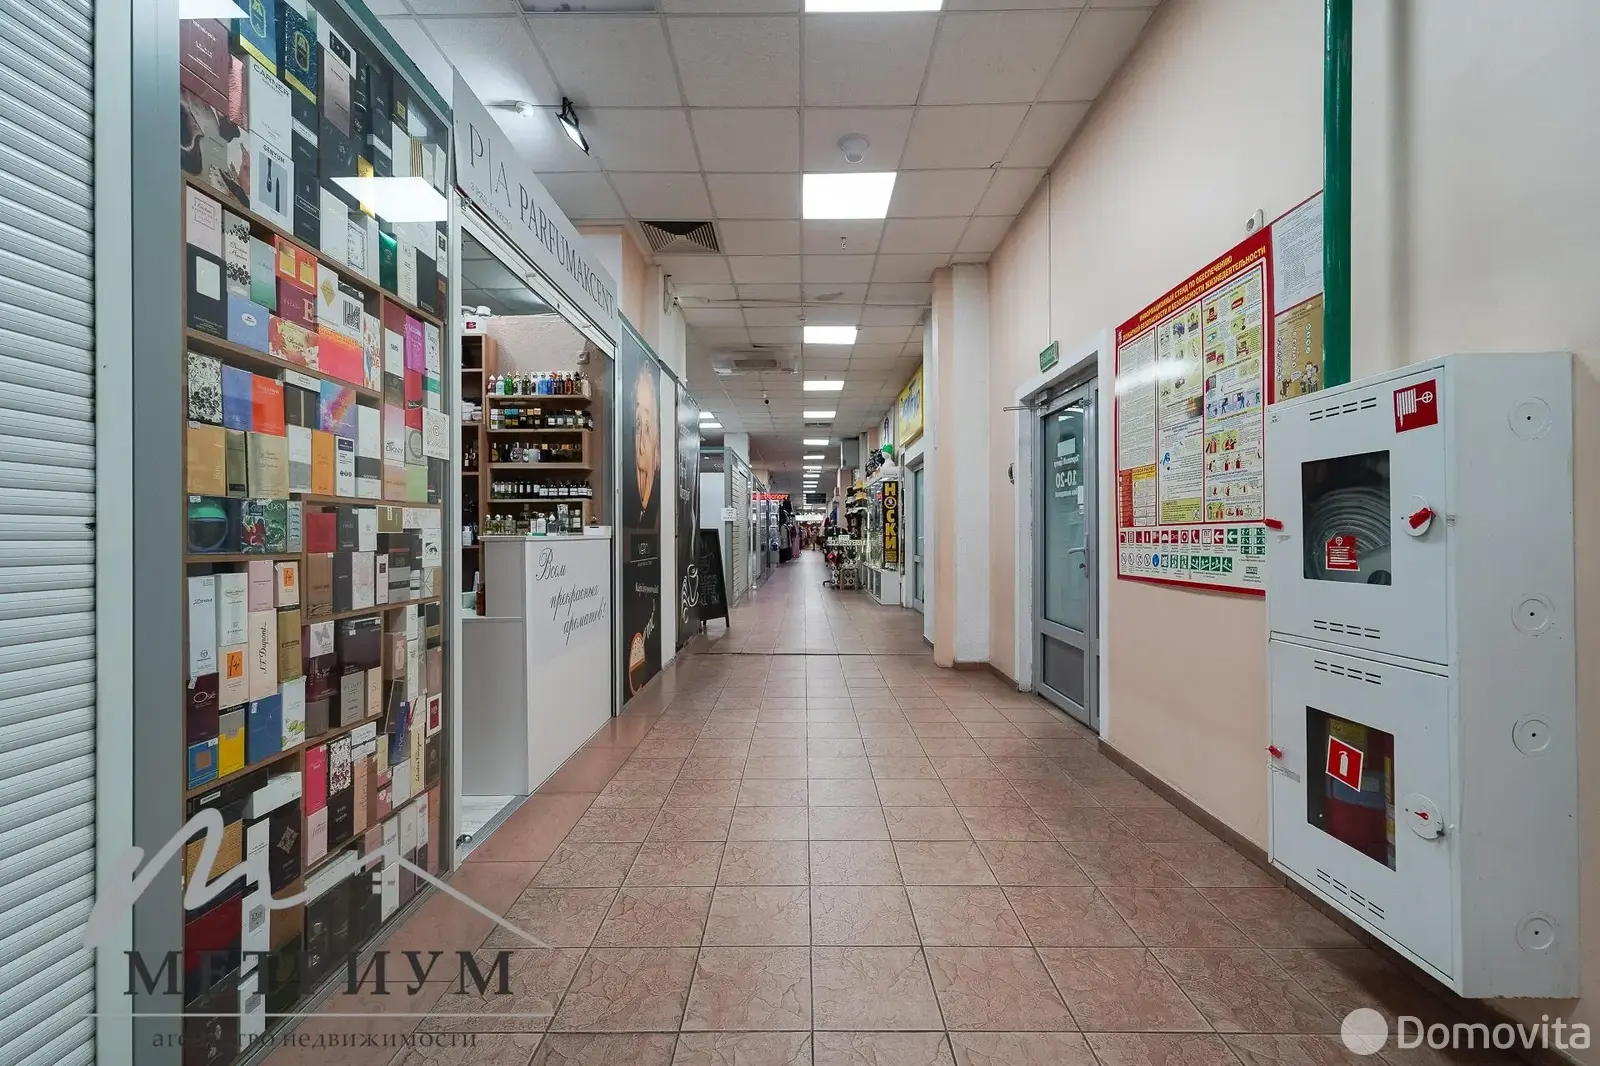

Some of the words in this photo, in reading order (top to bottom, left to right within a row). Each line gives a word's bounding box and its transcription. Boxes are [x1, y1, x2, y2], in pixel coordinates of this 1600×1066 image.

[253, 63, 290, 97] CARNER
[519, 181, 614, 320] PARFUMAKCENT
[1196, 255, 1233, 285] ОБЕСПЕЧЕНИЮ
[1204, 246, 1266, 291] ЖИЗНЕДЕЯТЕЛЬНОСТИ
[386, 445, 404, 454] DKNY
[884, 482, 898, 550] НОСКИ
